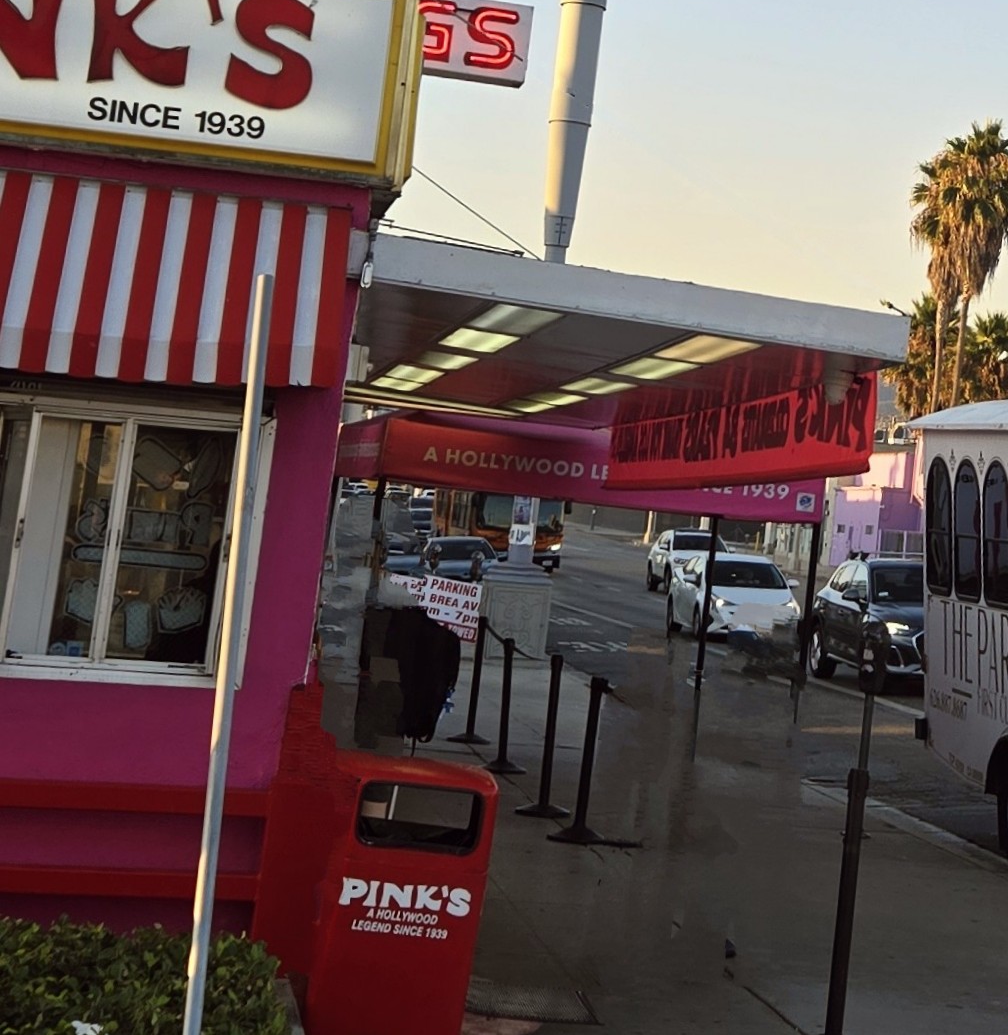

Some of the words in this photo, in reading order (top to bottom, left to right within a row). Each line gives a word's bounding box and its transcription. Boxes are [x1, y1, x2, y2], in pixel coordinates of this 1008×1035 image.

[87, 96, 182, 130] SINCE
[194, 110, 266, 139] 1939
[423, 446, 438, 462] A
[445, 448, 585, 478] HOLLYWOOD
[743, 484, 790, 500] 1939
[430, 578, 478, 598] PARKING
[429, 593, 459, 609] BREA
[462, 600, 480, 612] AV
[338, 876, 472, 917] PINK'S
[366, 908, 374, 918] A
[376, 909, 438, 925] HOLLYWOOD
[351, 919, 392, 933] LEGEND
[393, 924, 424, 937] SINCE
[426, 927, 448, 939] 1939
